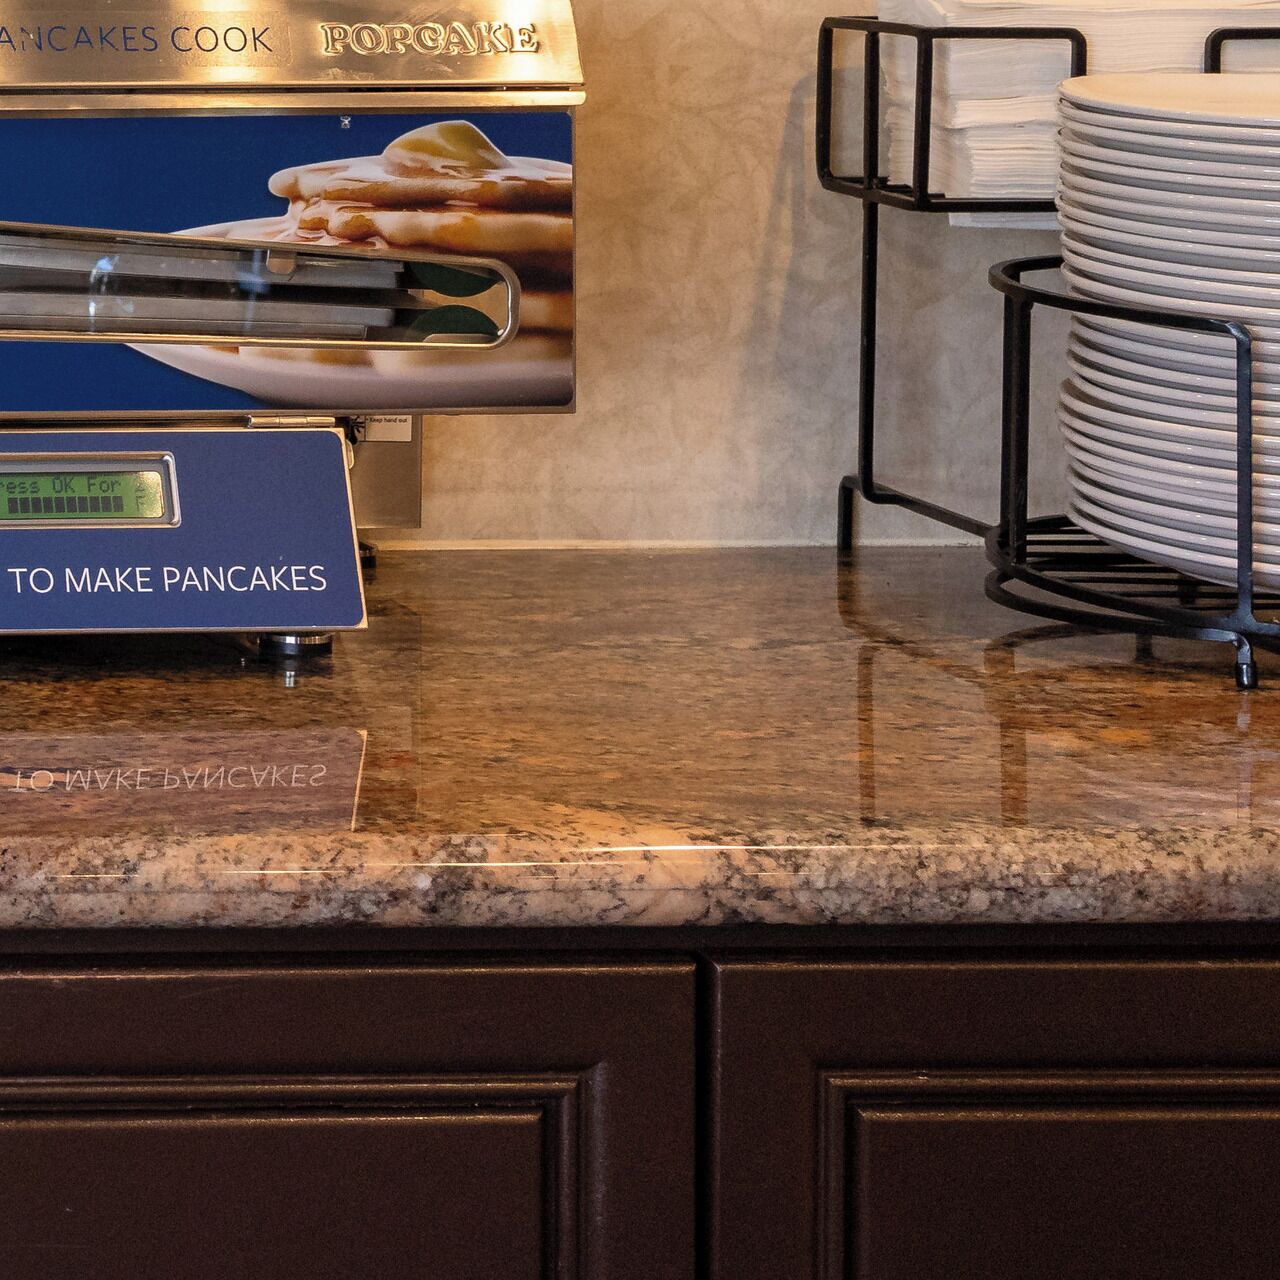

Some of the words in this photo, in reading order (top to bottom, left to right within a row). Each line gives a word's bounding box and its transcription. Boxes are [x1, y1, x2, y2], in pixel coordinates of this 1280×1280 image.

[170, 25, 274, 52] COOK
[319, 22, 540, 55] POPCAKE
[52, 476, 76, 493] OK
[87, 476, 122, 493] For
[7, 567, 55, 594] TO
[65, 567, 153, 593] MAKE
[163, 565, 327, 592] PANCAKES
